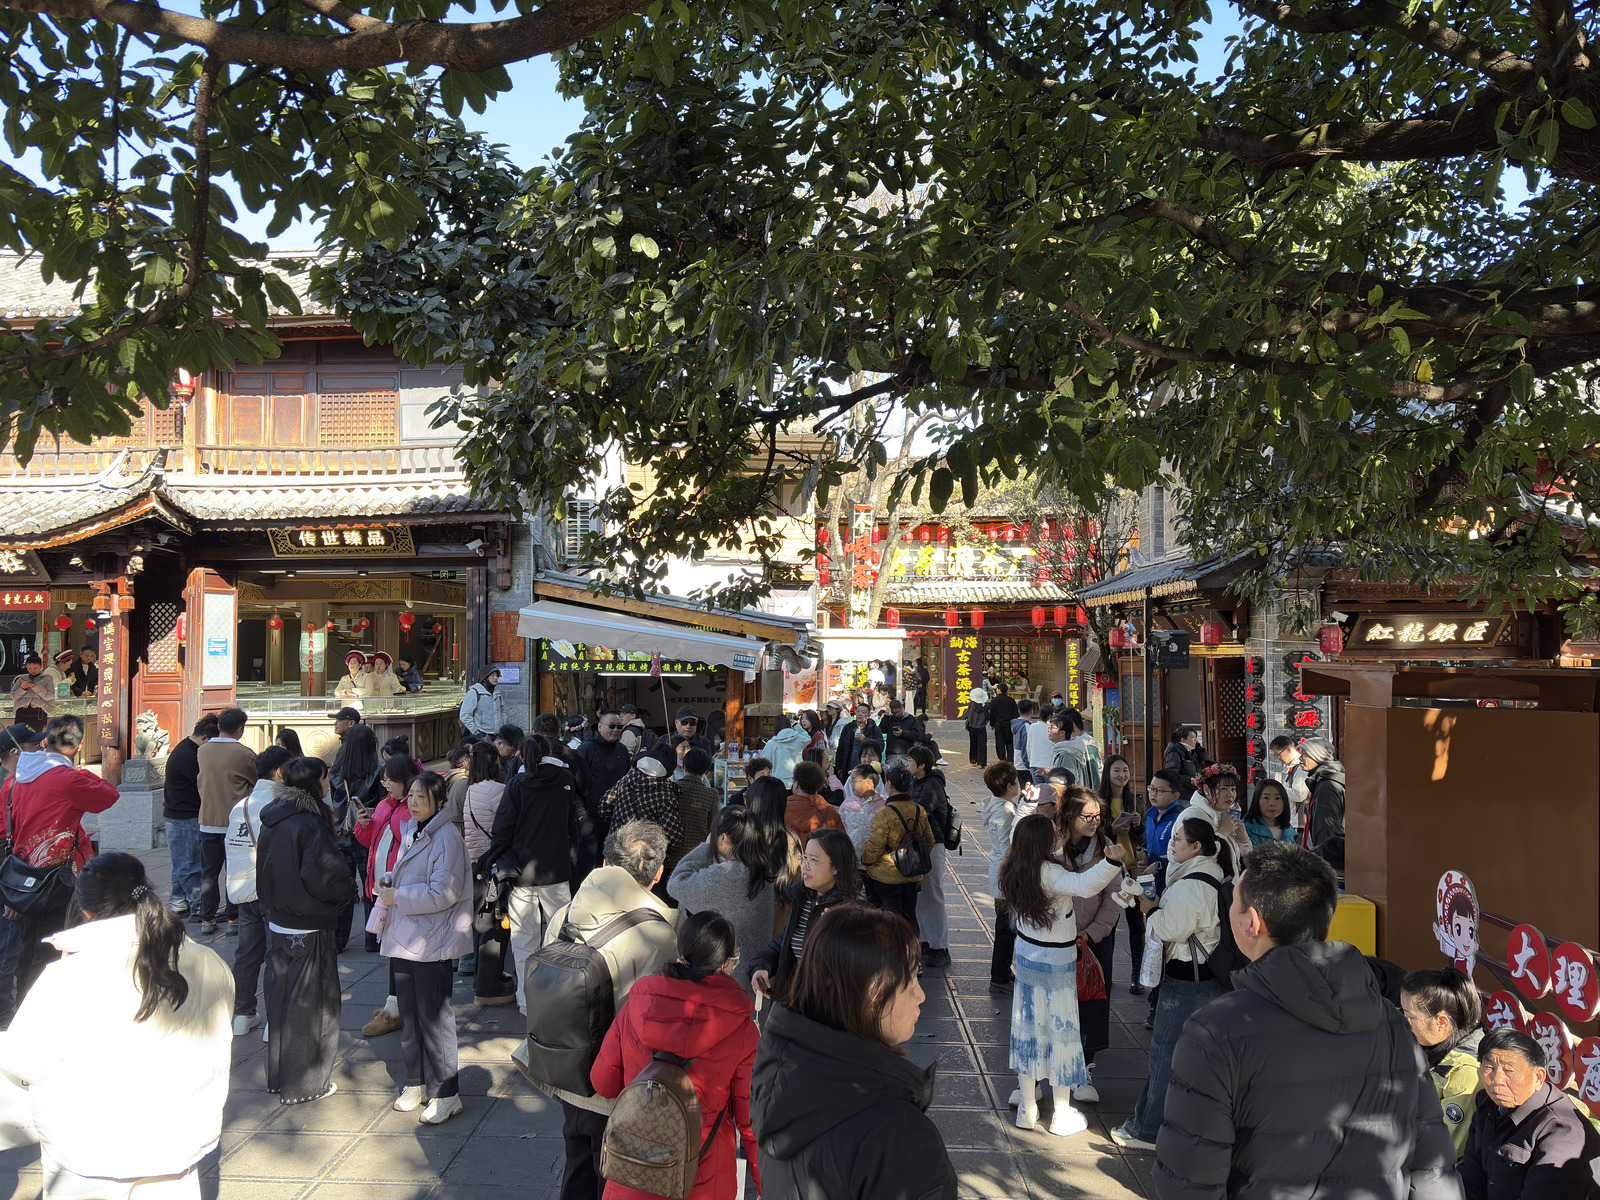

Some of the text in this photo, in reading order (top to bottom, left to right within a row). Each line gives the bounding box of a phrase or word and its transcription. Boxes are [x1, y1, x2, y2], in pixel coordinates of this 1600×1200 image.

[299, 530, 385, 546] 传世臻品
[1366, 621, 1489, 642] 紅龍銀匠
[548, 661, 717, 673] 大理纯手工现做现烤族特色小吃
[956, 650, 973, 718] 古茶源茶厂
[1068, 642, 1080, 712] 古茶源茶厂配送中
[1246, 657, 1257, 783] 古茶源茶厂
[1512, 932, 1588, 1010] 大理
